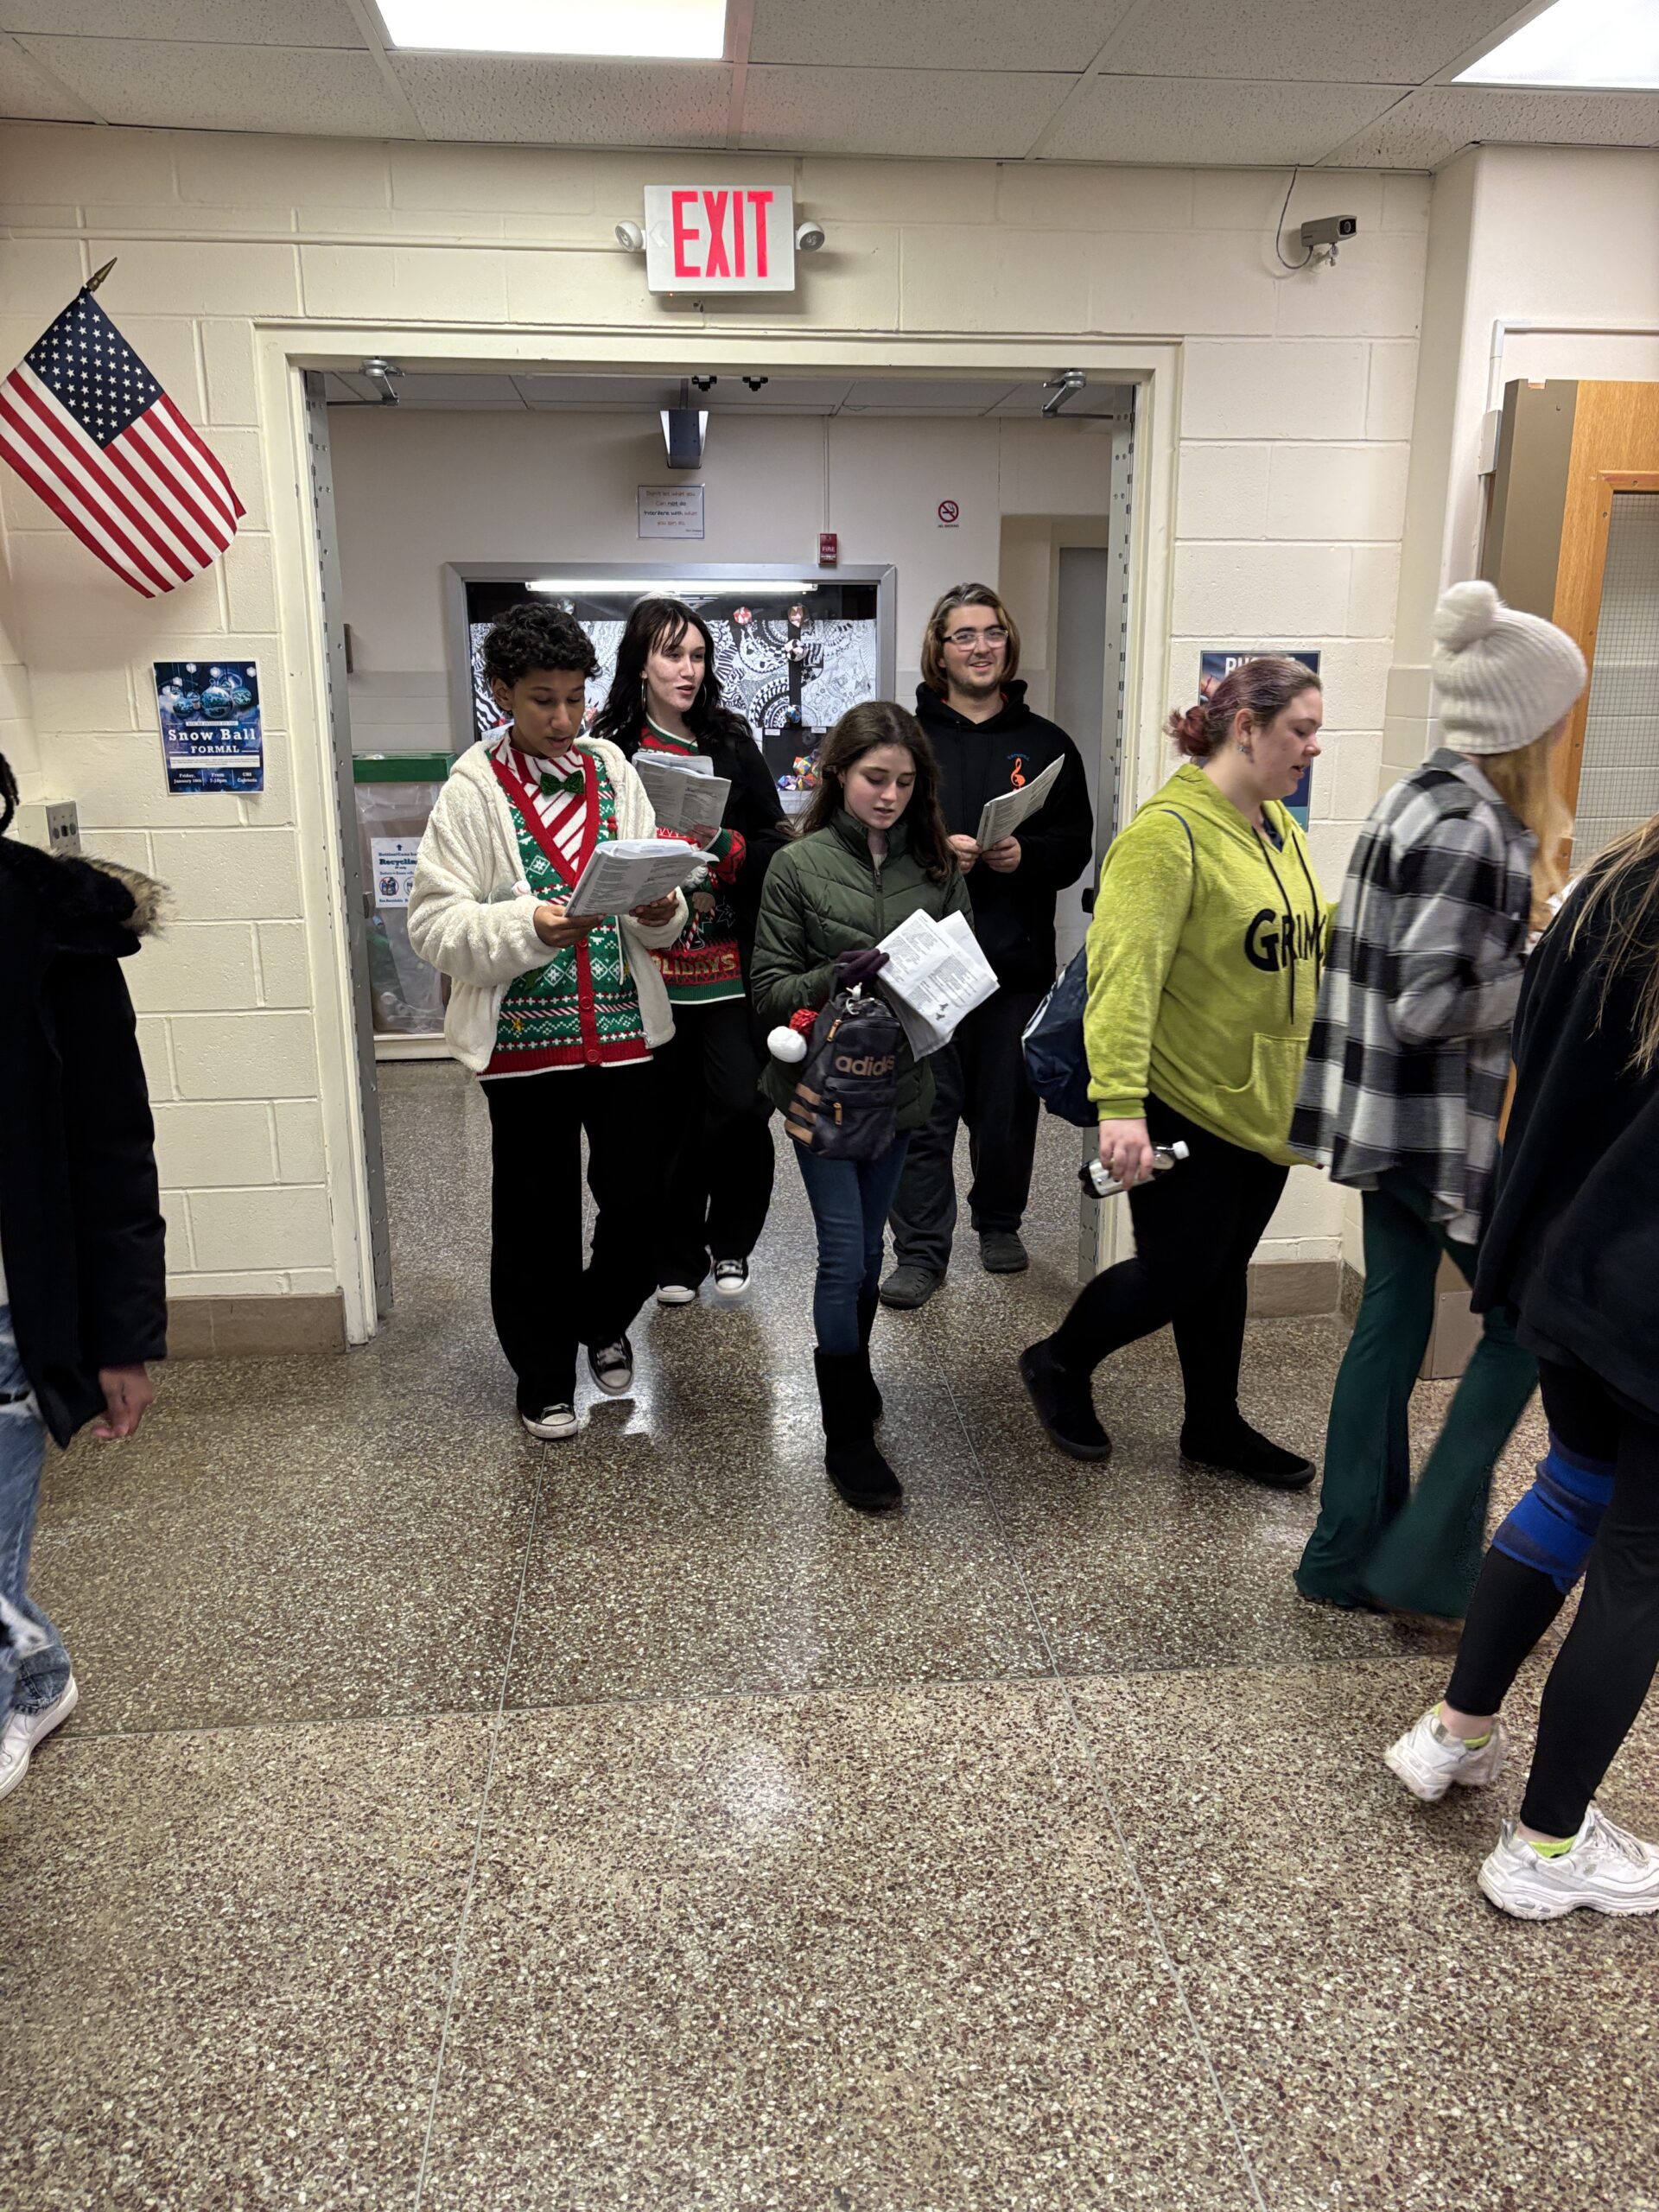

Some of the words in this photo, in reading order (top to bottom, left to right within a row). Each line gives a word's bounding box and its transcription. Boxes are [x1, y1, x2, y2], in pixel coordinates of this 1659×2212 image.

[671, 190, 775, 278] EXIT
[168, 729, 213, 741] Snow
[220, 728, 257, 741] Ball
